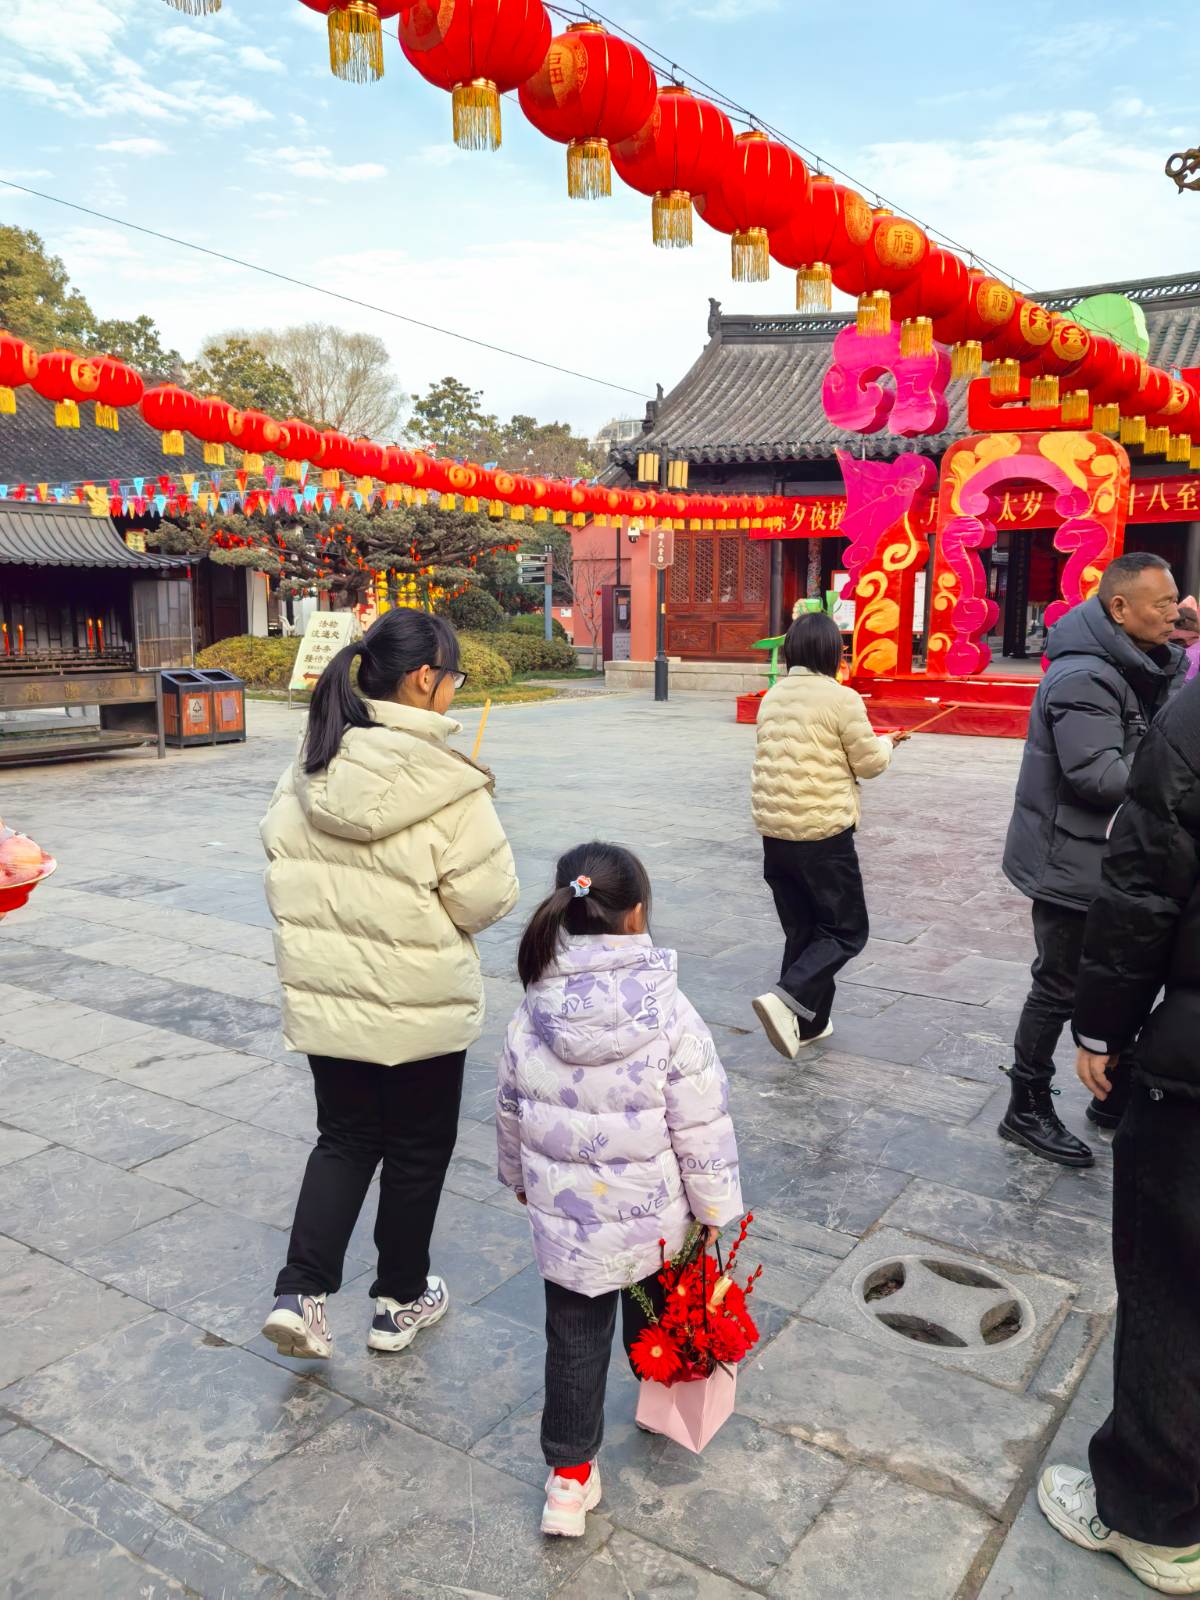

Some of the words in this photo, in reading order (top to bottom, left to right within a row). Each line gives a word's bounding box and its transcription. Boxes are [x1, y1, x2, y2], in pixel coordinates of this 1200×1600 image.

[894, 230, 914, 255] 福
[992, 290, 1008, 312] 福
[996, 490, 1043, 523] 太岁
[645, 982, 659, 1030] LOVE
[618, 1198, 665, 1221] LOVE
